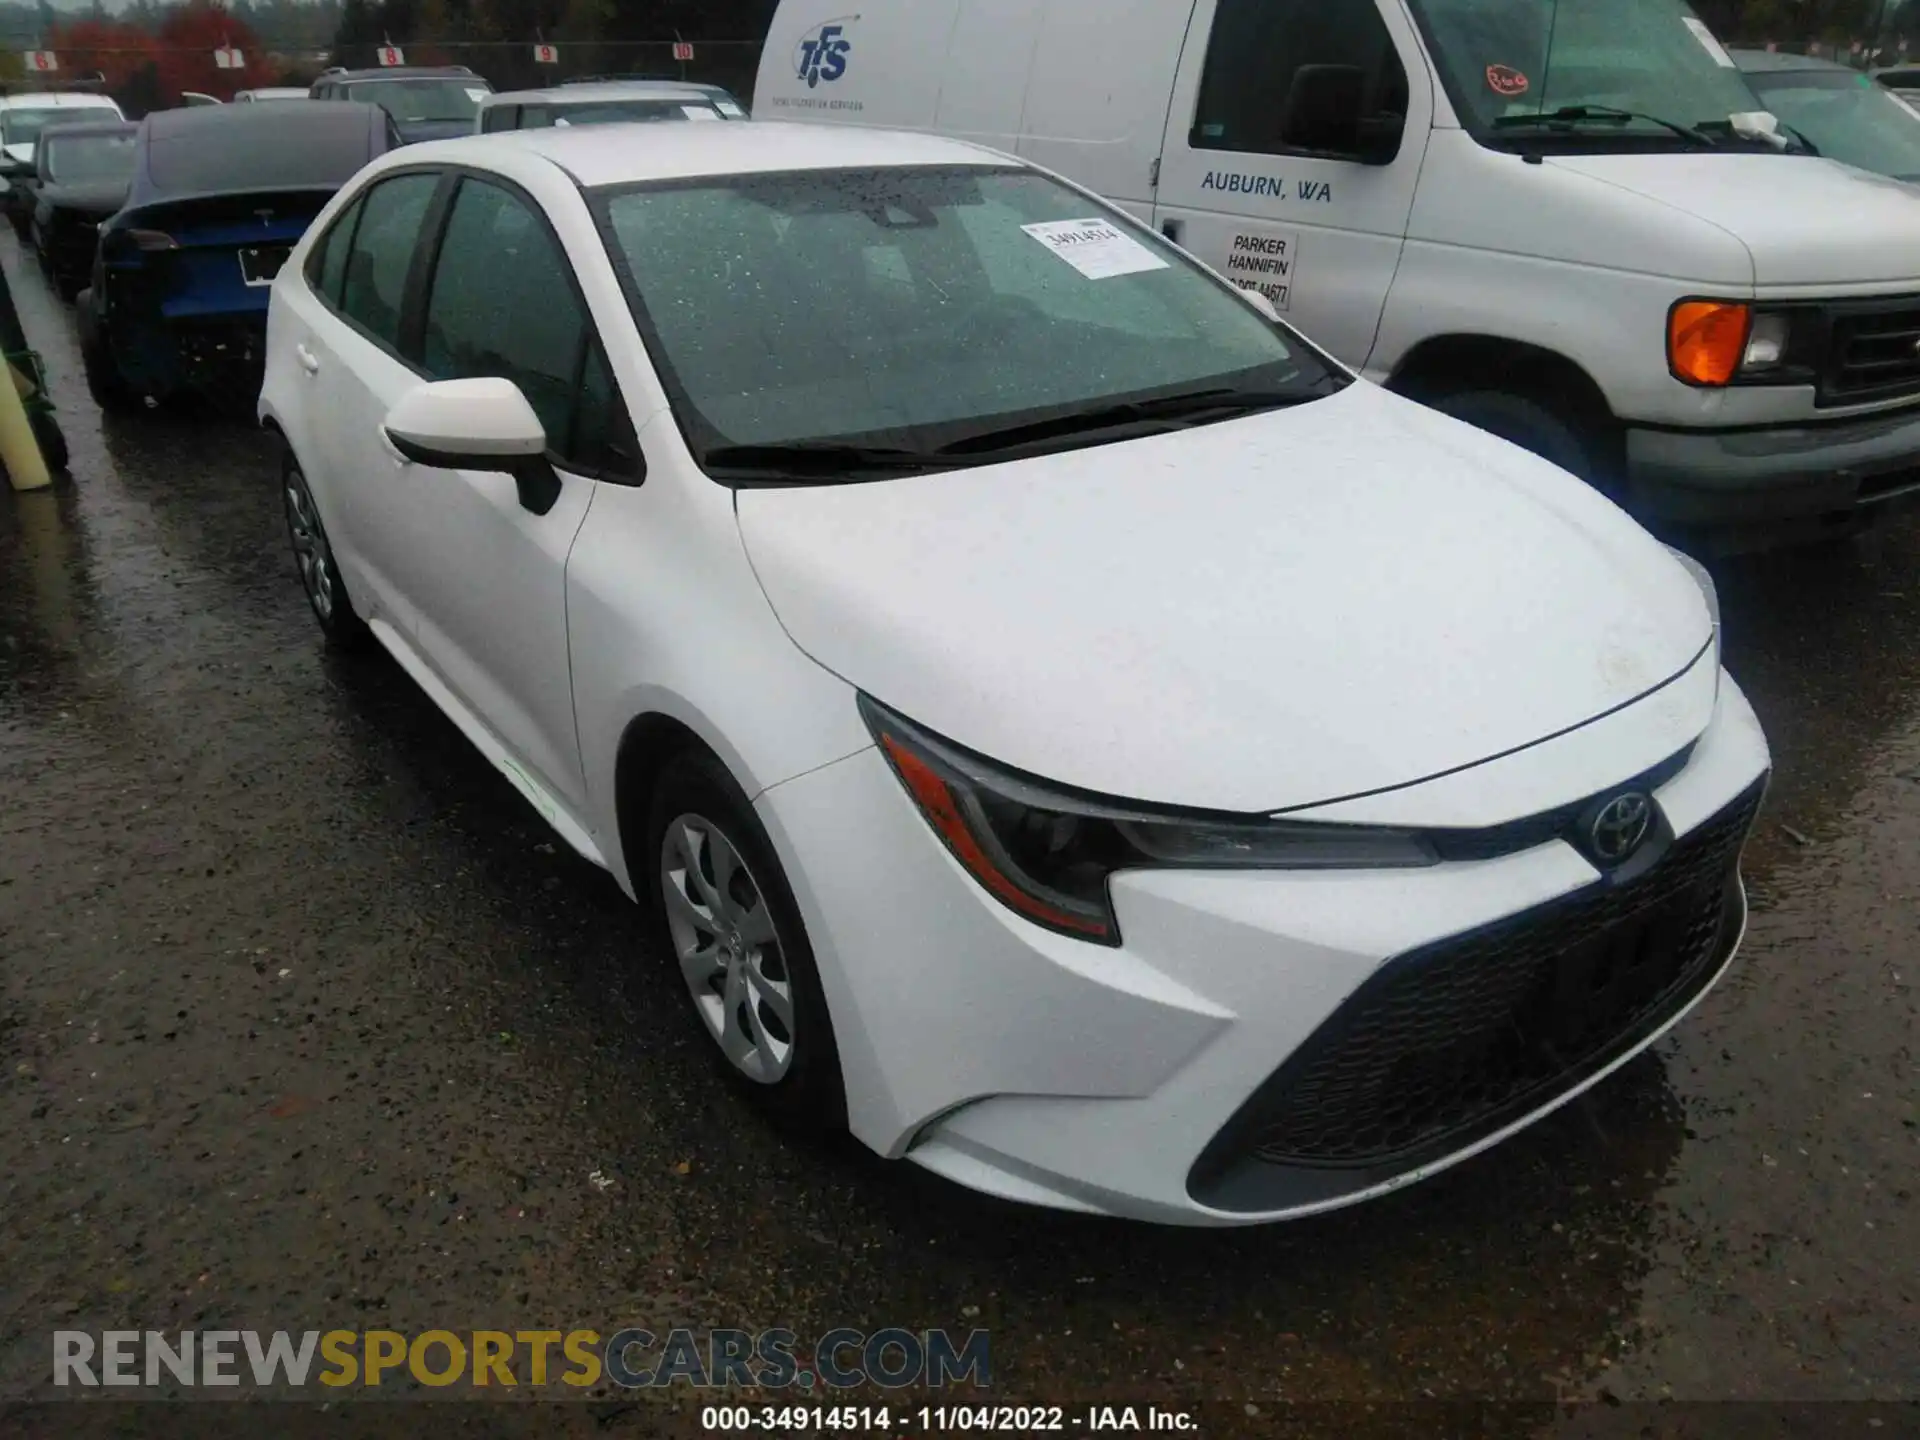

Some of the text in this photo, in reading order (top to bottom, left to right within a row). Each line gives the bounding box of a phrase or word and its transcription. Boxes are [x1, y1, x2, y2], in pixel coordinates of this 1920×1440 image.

[386, 48, 397, 65] 8
[541, 46, 551, 61] 9
[675, 43, 692, 59] 10
[800, 26, 852, 81] TFS
[35, 52, 48, 69] 6
[1200, 171, 1331, 203] AUBURN, WA
[1234, 235, 1287, 255] PARKER
[1227, 254, 1289, 276] HANNIFIN
